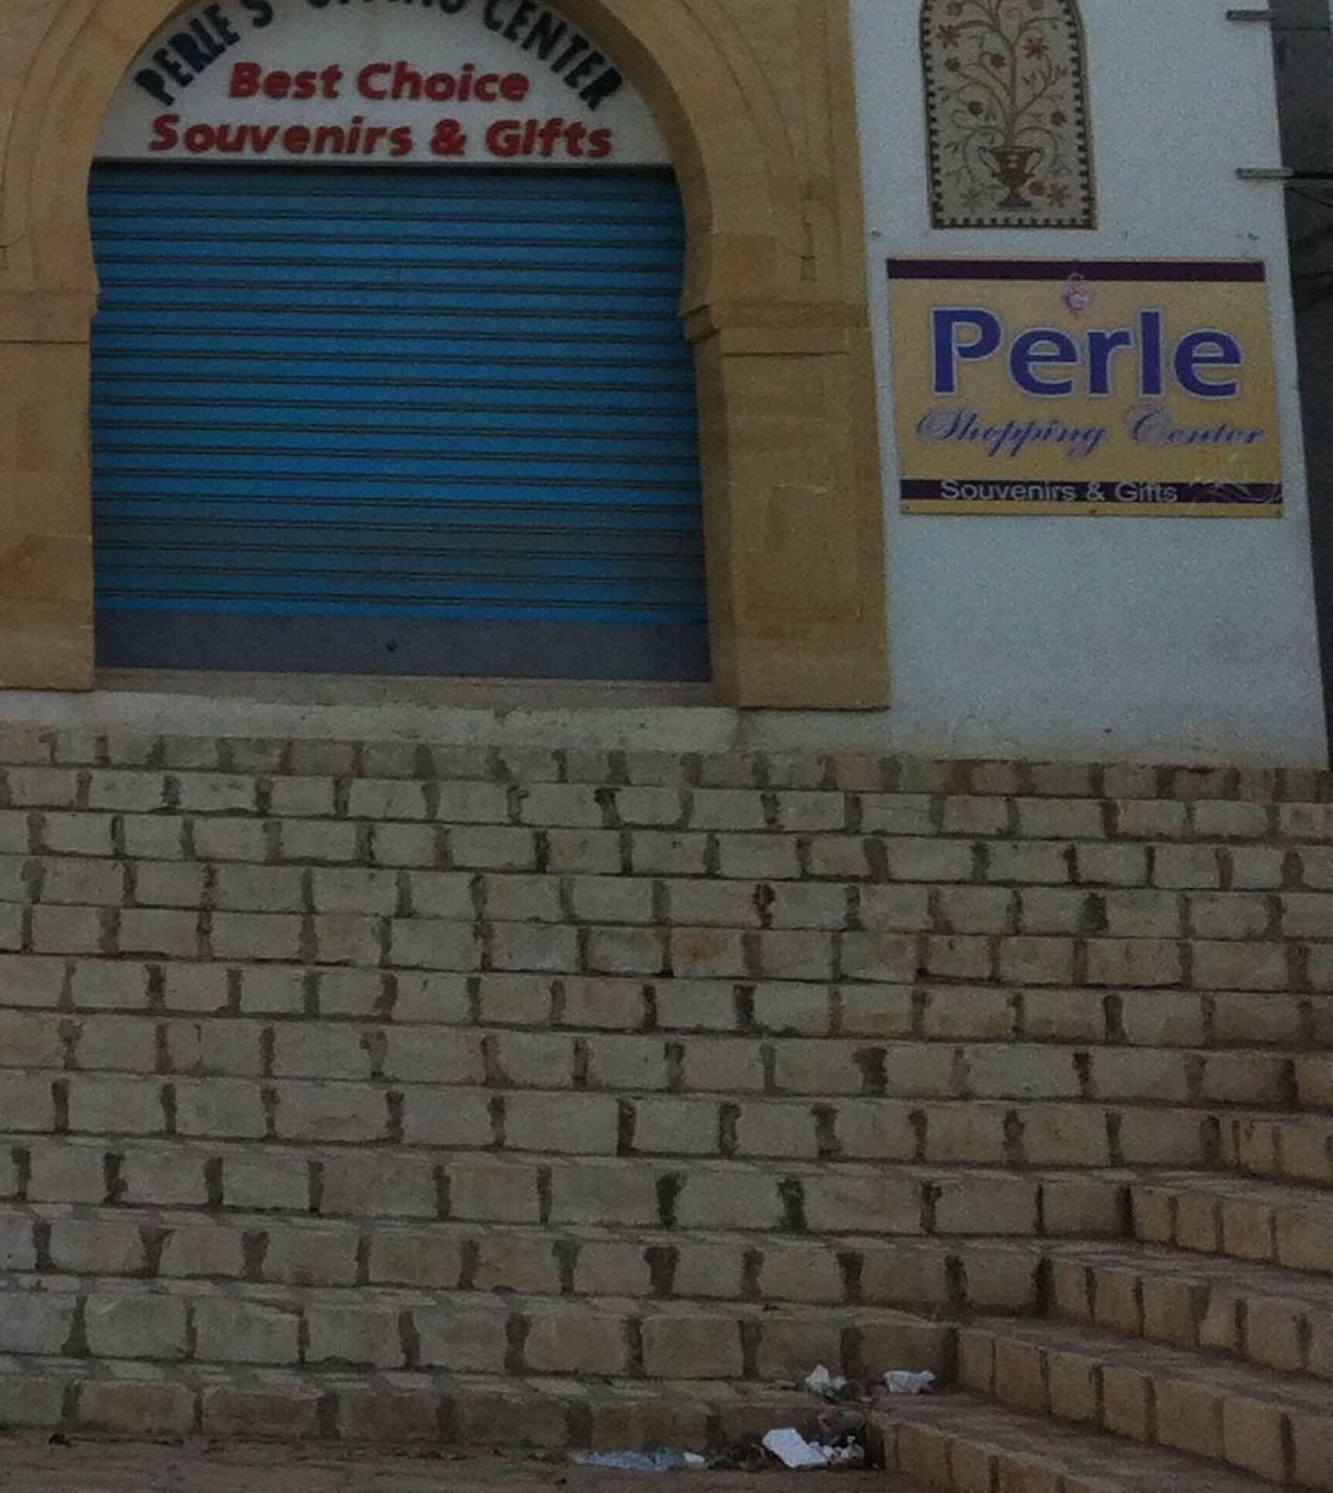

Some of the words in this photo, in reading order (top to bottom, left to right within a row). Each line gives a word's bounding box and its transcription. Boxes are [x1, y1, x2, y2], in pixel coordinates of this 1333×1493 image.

[134, 2, 241, 107] PERLE
[228, 61, 343, 100] Best
[357, 60, 531, 103] Choice
[149, 113, 413, 157] Souvenirs
[429, 118, 466, 157] &
[932, 307, 1244, 400] Perle
[916, 408, 1107, 459] Shopping
[1126, 404, 1266, 447] Center
[939, 480, 1077, 502] Souvenirs
[1087, 482, 1106, 503] &
[1114, 481, 1178, 504] Gifts
